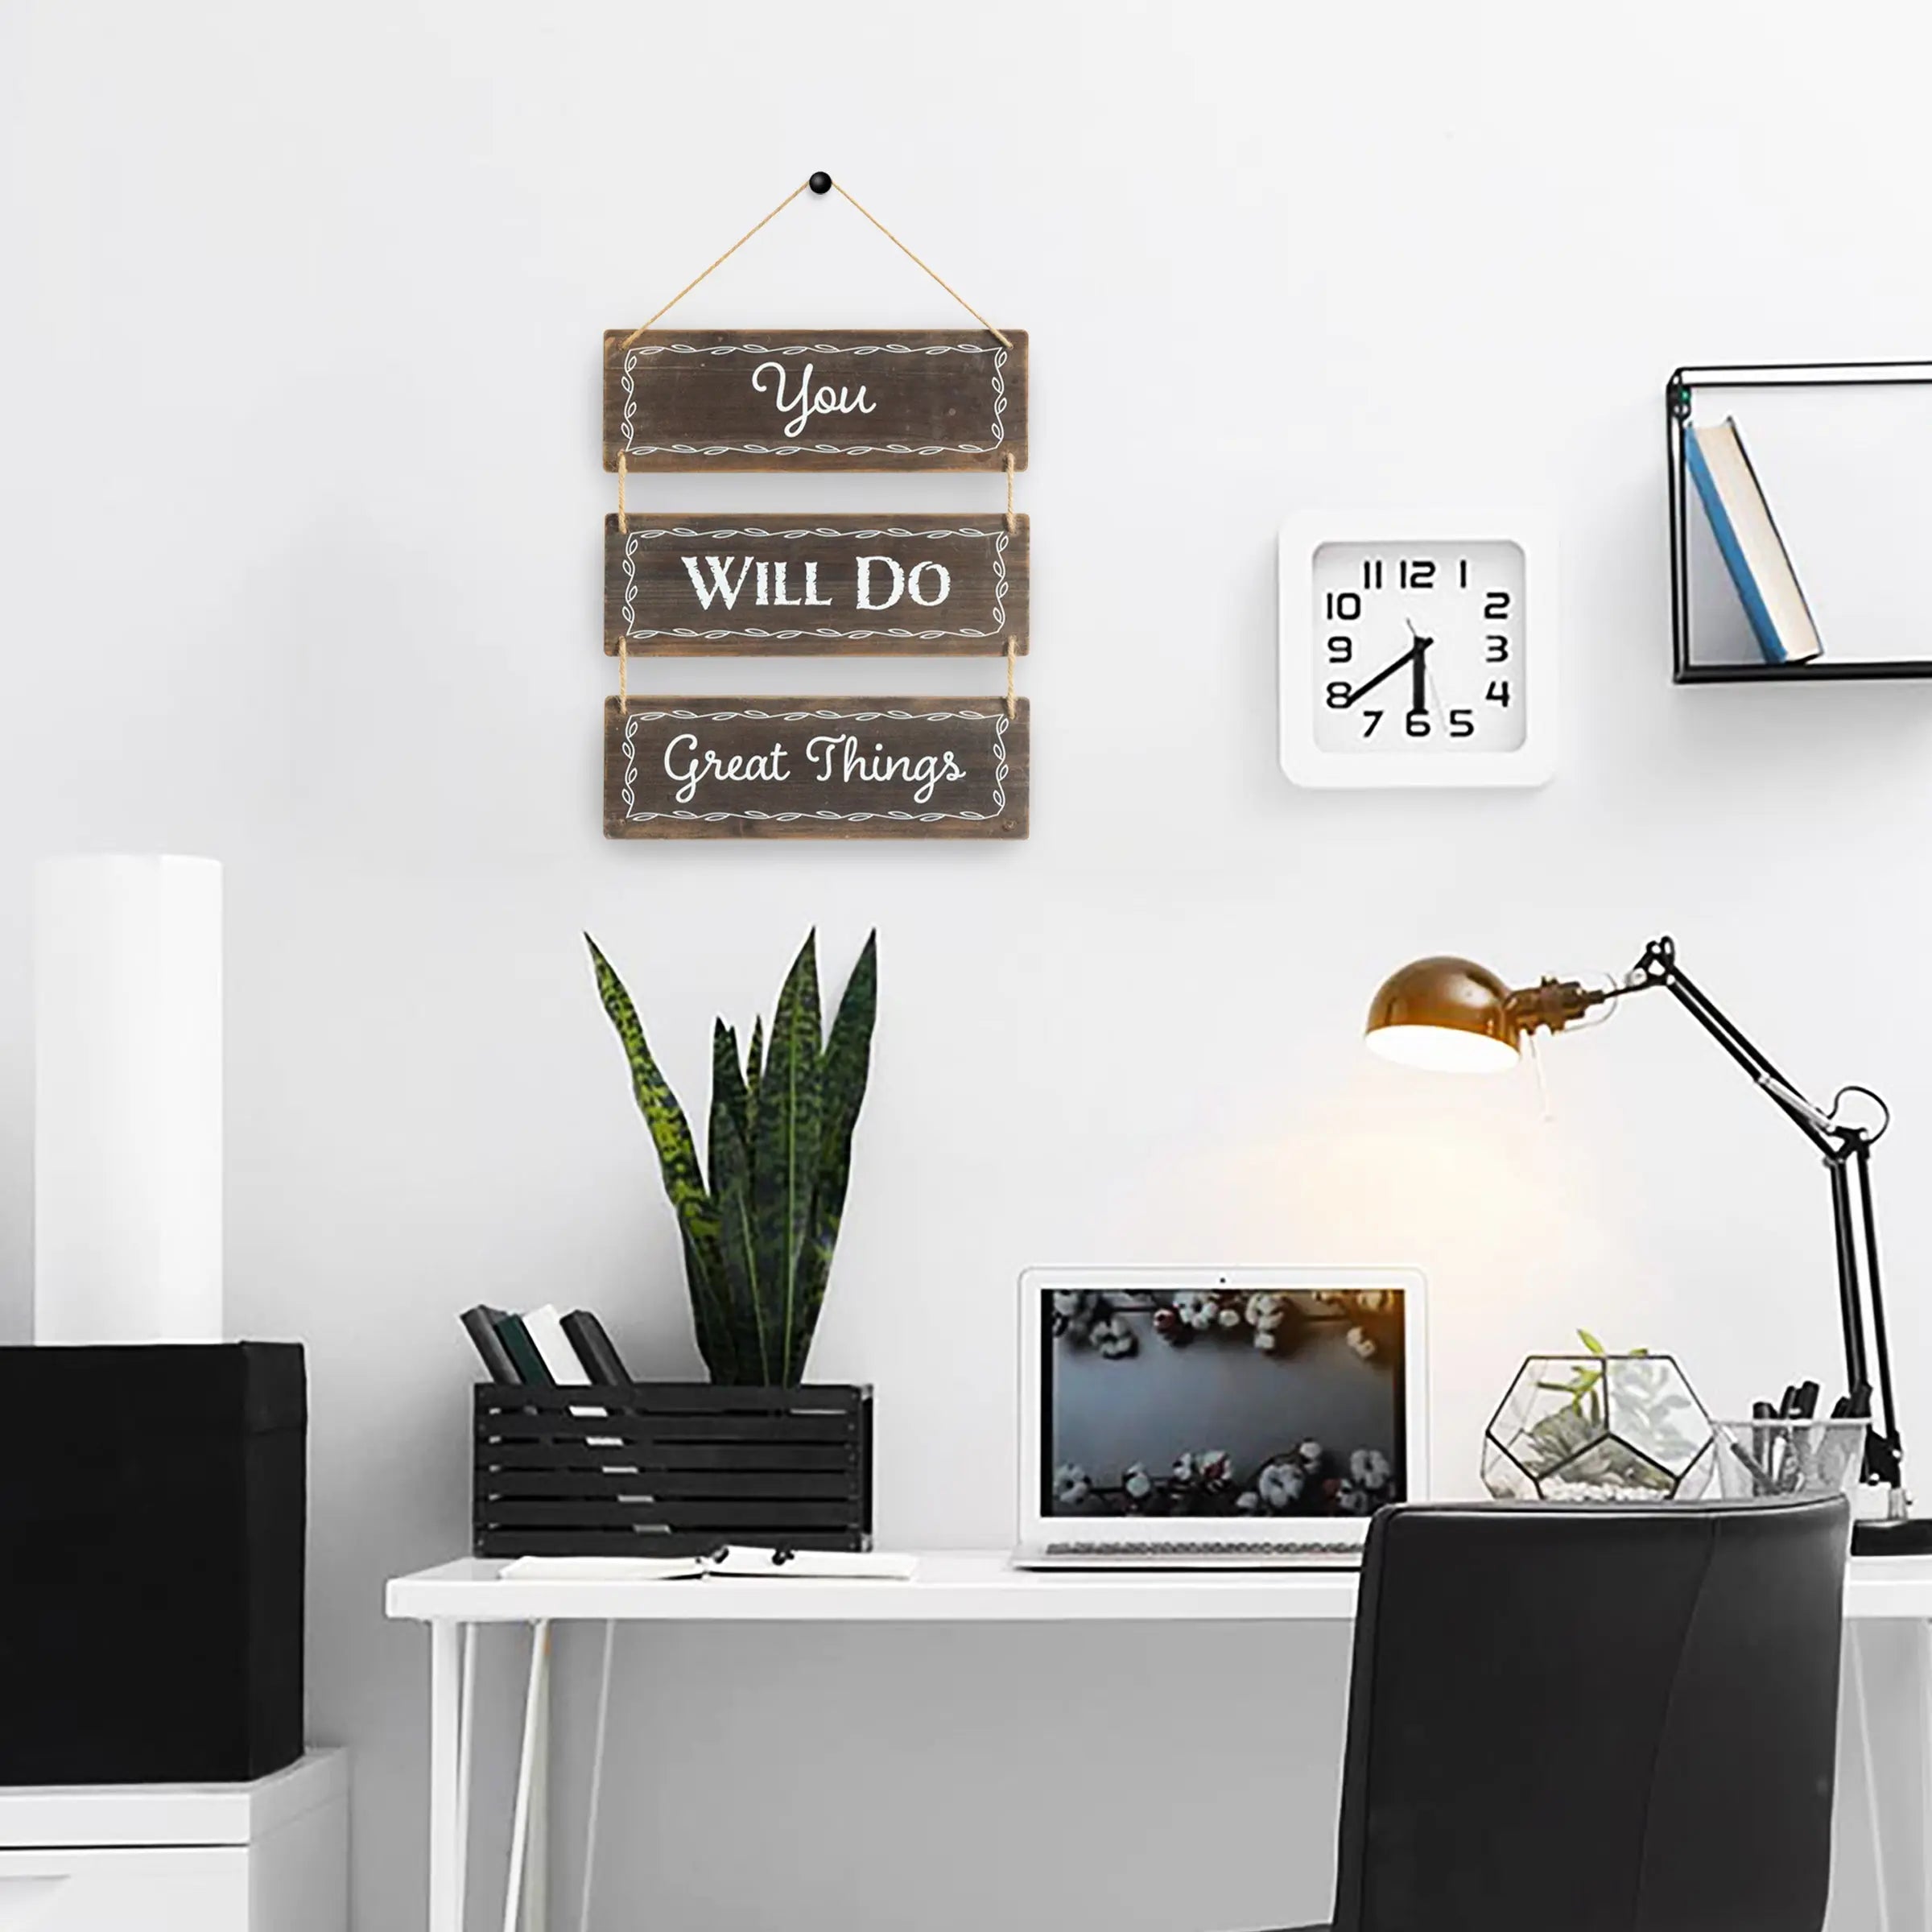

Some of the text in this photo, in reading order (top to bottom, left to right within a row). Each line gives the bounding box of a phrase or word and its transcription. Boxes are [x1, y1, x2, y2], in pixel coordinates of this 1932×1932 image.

[751, 361, 877, 438] You
[680, 555, 833, 611] WILL
[1364, 559, 1382, 589] 11
[1400, 559, 1436, 589] 12
[1459, 559, 1467, 588] 1
[1327, 592, 1361, 621] 10
[1484, 592, 1510, 620] 2
[1327, 636, 1352, 663] 9
[1486, 635, 1509, 663] 3
[1326, 681, 1352, 709] 8
[1485, 680, 1510, 708] 4
[1363, 710, 1384, 737] 7
[1406, 709, 1431, 737] 6
[1450, 709, 1475, 737] 5
[663, 733, 967, 804] Great Things
